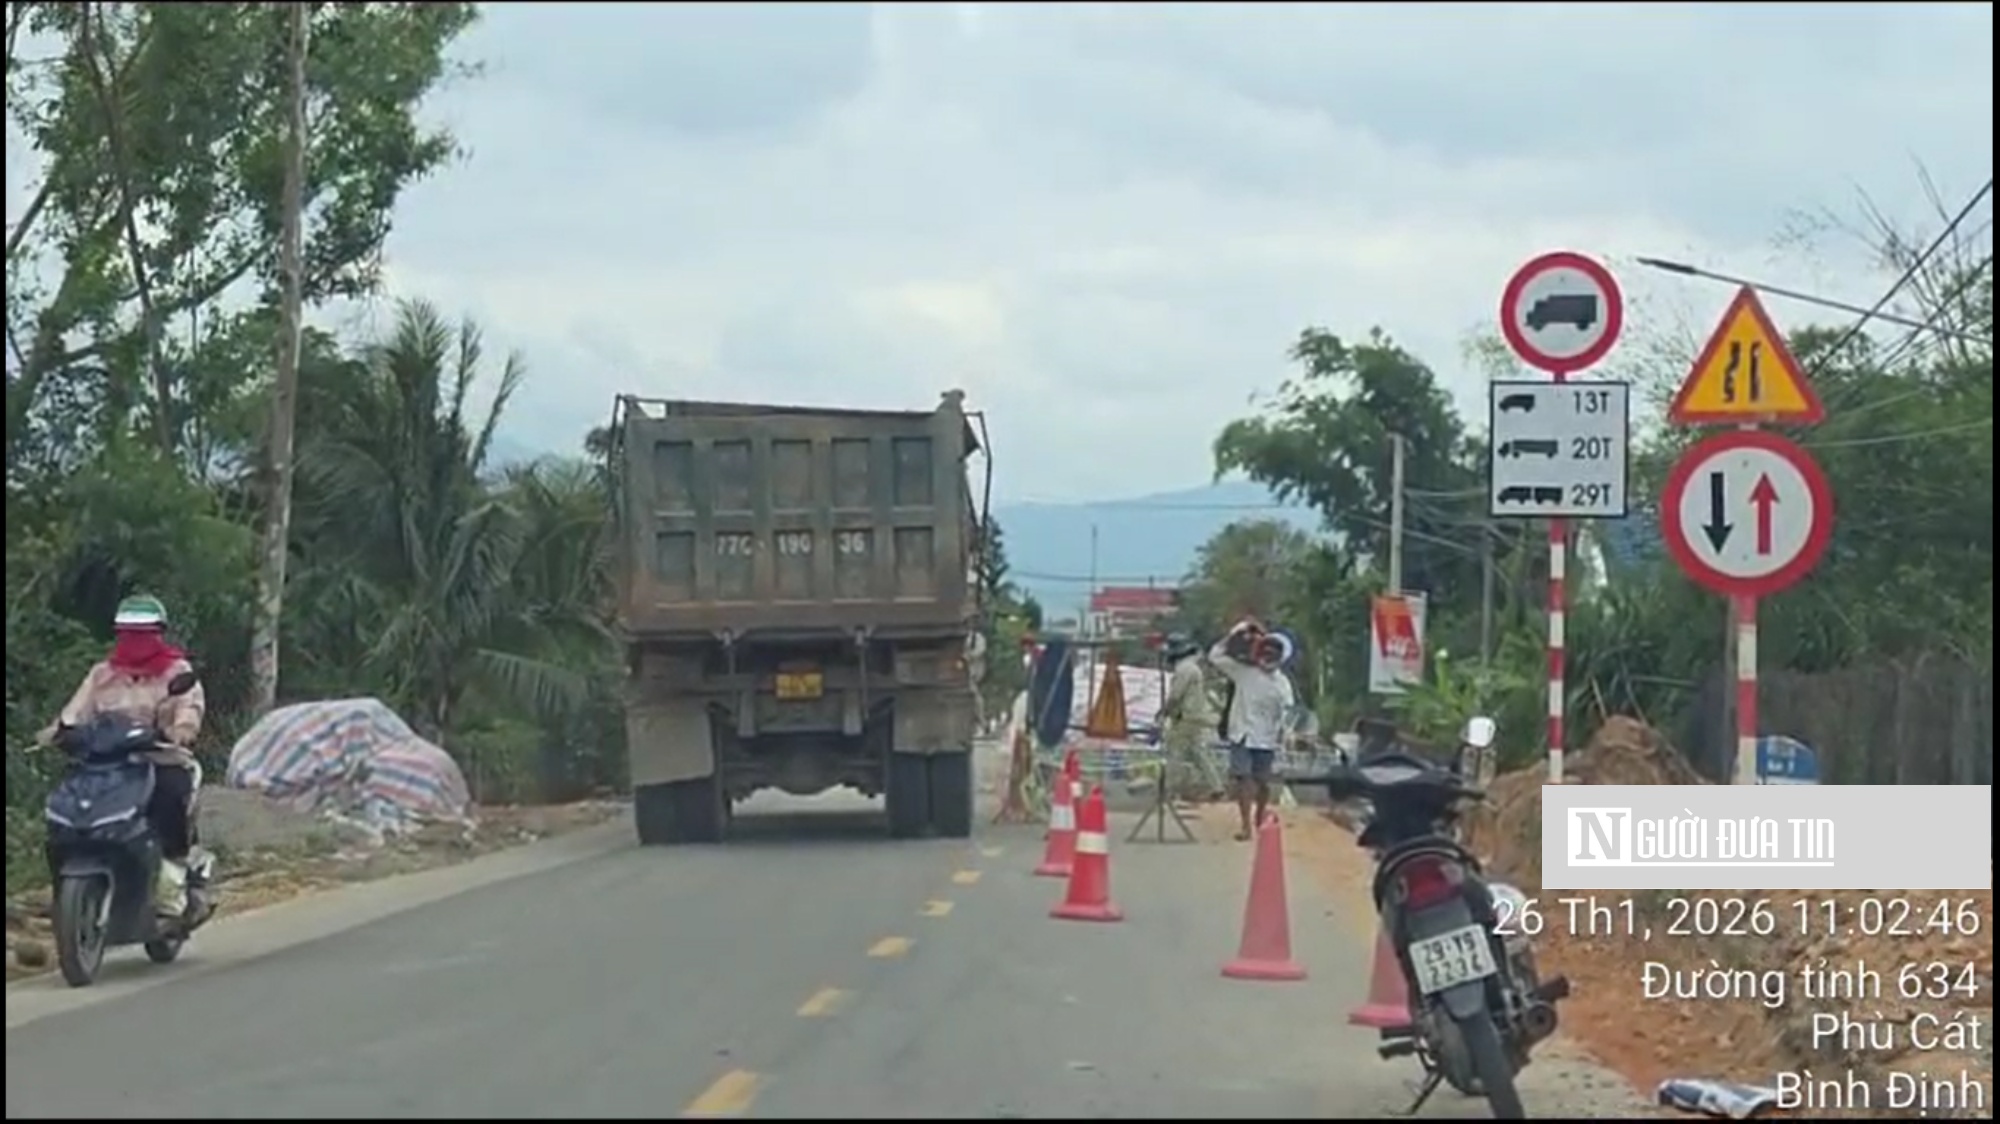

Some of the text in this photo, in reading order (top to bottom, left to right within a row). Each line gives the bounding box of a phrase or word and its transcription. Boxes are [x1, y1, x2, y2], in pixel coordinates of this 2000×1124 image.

[1573, 390, 1610, 414] 13T
[1572, 436, 1612, 459] 20T
[1571, 483, 1611, 507] 29T
